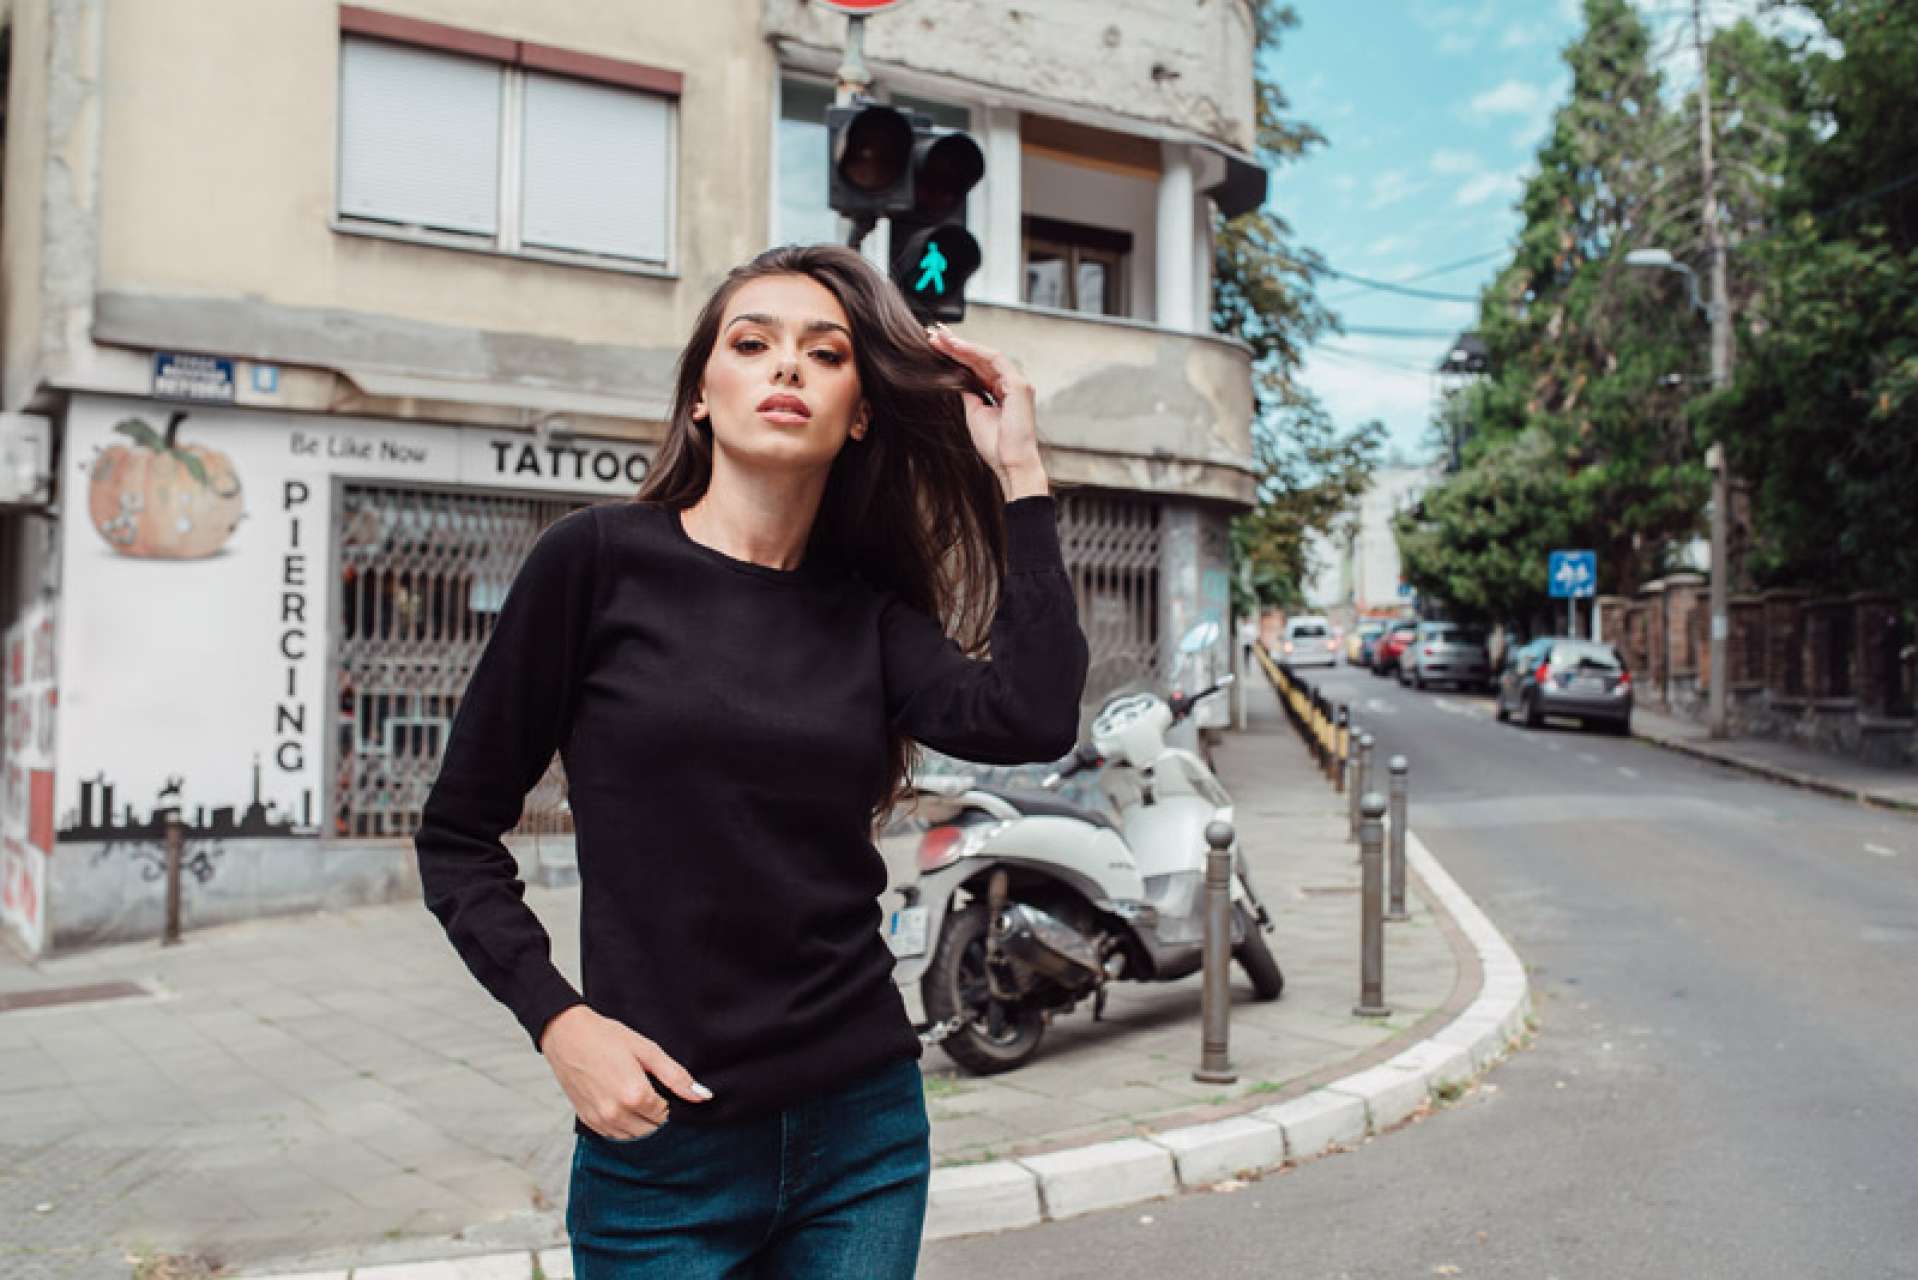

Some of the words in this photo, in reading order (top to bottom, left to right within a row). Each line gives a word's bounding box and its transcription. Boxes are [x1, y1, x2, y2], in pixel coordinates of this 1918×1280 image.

[290, 431, 320, 456] Be
[328, 435, 371, 461] Like
[379, 438, 428, 464] Now
[490, 439, 650, 483] TATTOO
[277, 480, 309, 772] PIERCING
